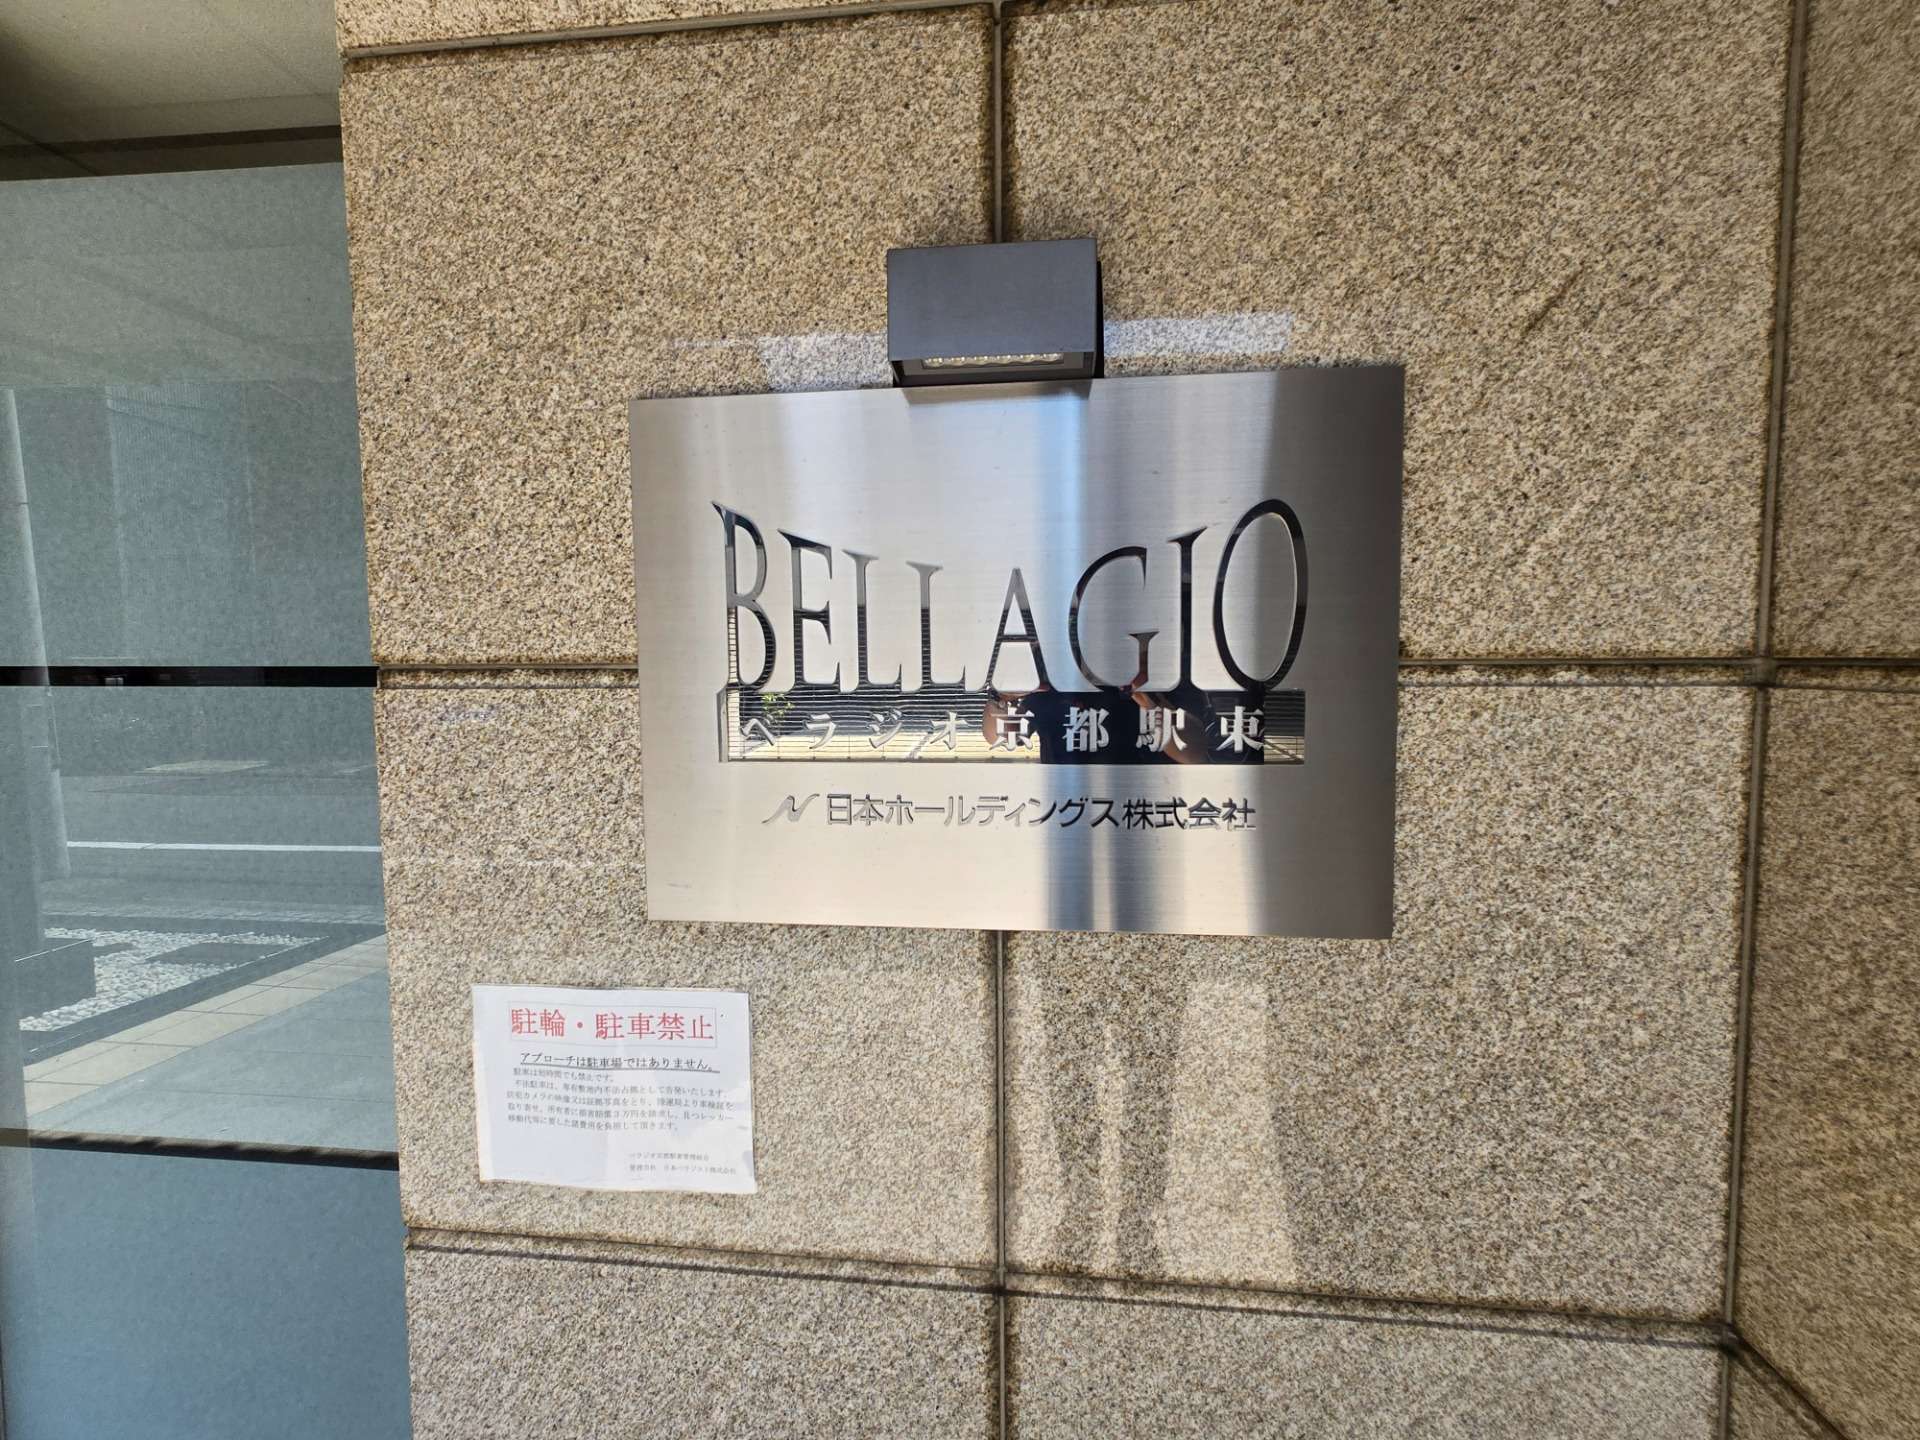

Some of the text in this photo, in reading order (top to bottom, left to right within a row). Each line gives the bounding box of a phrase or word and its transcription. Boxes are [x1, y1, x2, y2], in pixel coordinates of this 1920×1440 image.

[711, 498, 1309, 694] BELLAGIO
[826, 793, 1257, 832] 日本ホールディングス株式会社
[510, 1007, 715, 1042] 駐輪・駐車禁止
